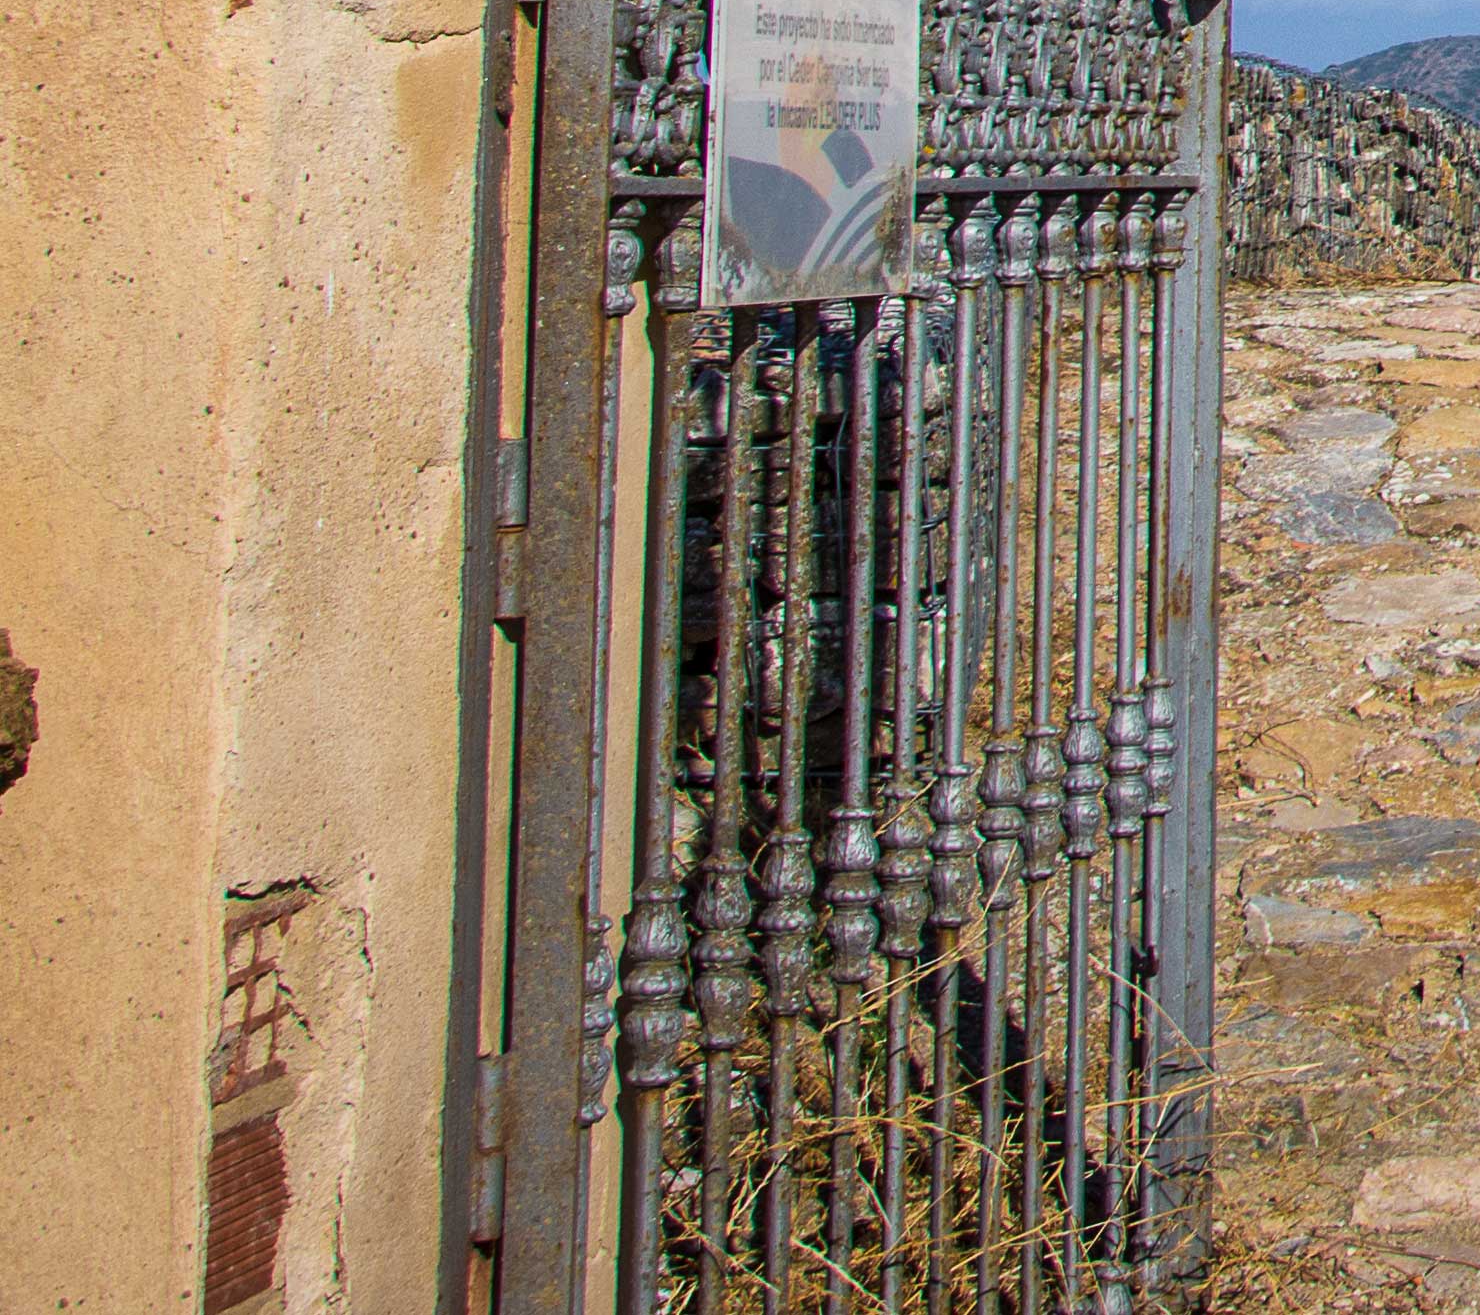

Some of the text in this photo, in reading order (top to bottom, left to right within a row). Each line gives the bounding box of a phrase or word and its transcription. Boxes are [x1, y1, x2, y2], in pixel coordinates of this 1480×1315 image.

[755, 4, 776, 35] Este
[778, 12, 818, 46] proyecto
[833, 14, 852, 42] sido
[853, 14, 895, 45] financiado
[760, 56, 775, 89] por
[777, 51, 785, 82] el
[767, 98, 775, 128] la
[819, 99, 857, 130] LEADER
[858, 101, 881, 131] PLUS
